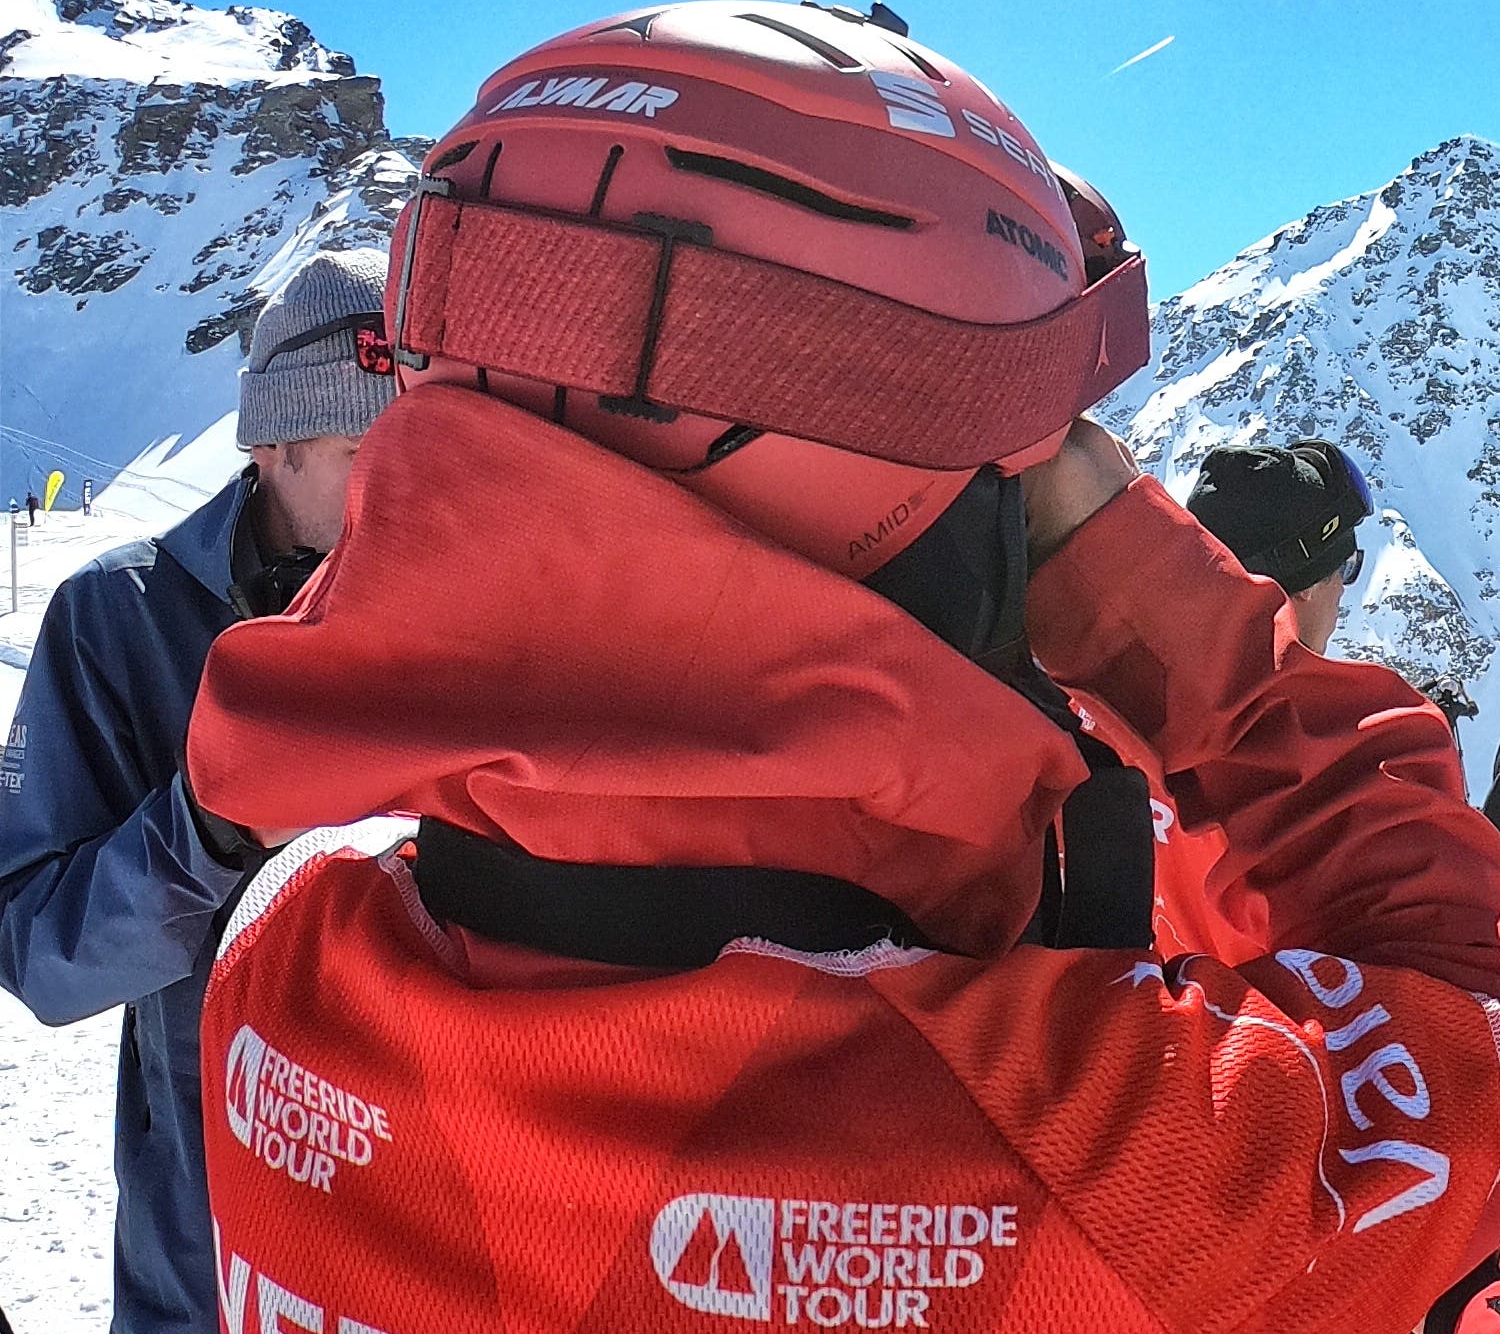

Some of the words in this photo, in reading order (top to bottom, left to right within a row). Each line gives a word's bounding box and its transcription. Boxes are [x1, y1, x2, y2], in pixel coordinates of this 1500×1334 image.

[986, 208, 1069, 282] ATOMIC
[259, 1082, 372, 1166] WORLD
[260, 1046, 393, 1142] FREERIDE
[254, 1119, 332, 1194] TOUR
[780, 1199, 1019, 1247] FREERIDE
[782, 1242, 985, 1288] WORLD
[778, 1284, 930, 1329] TOUR
